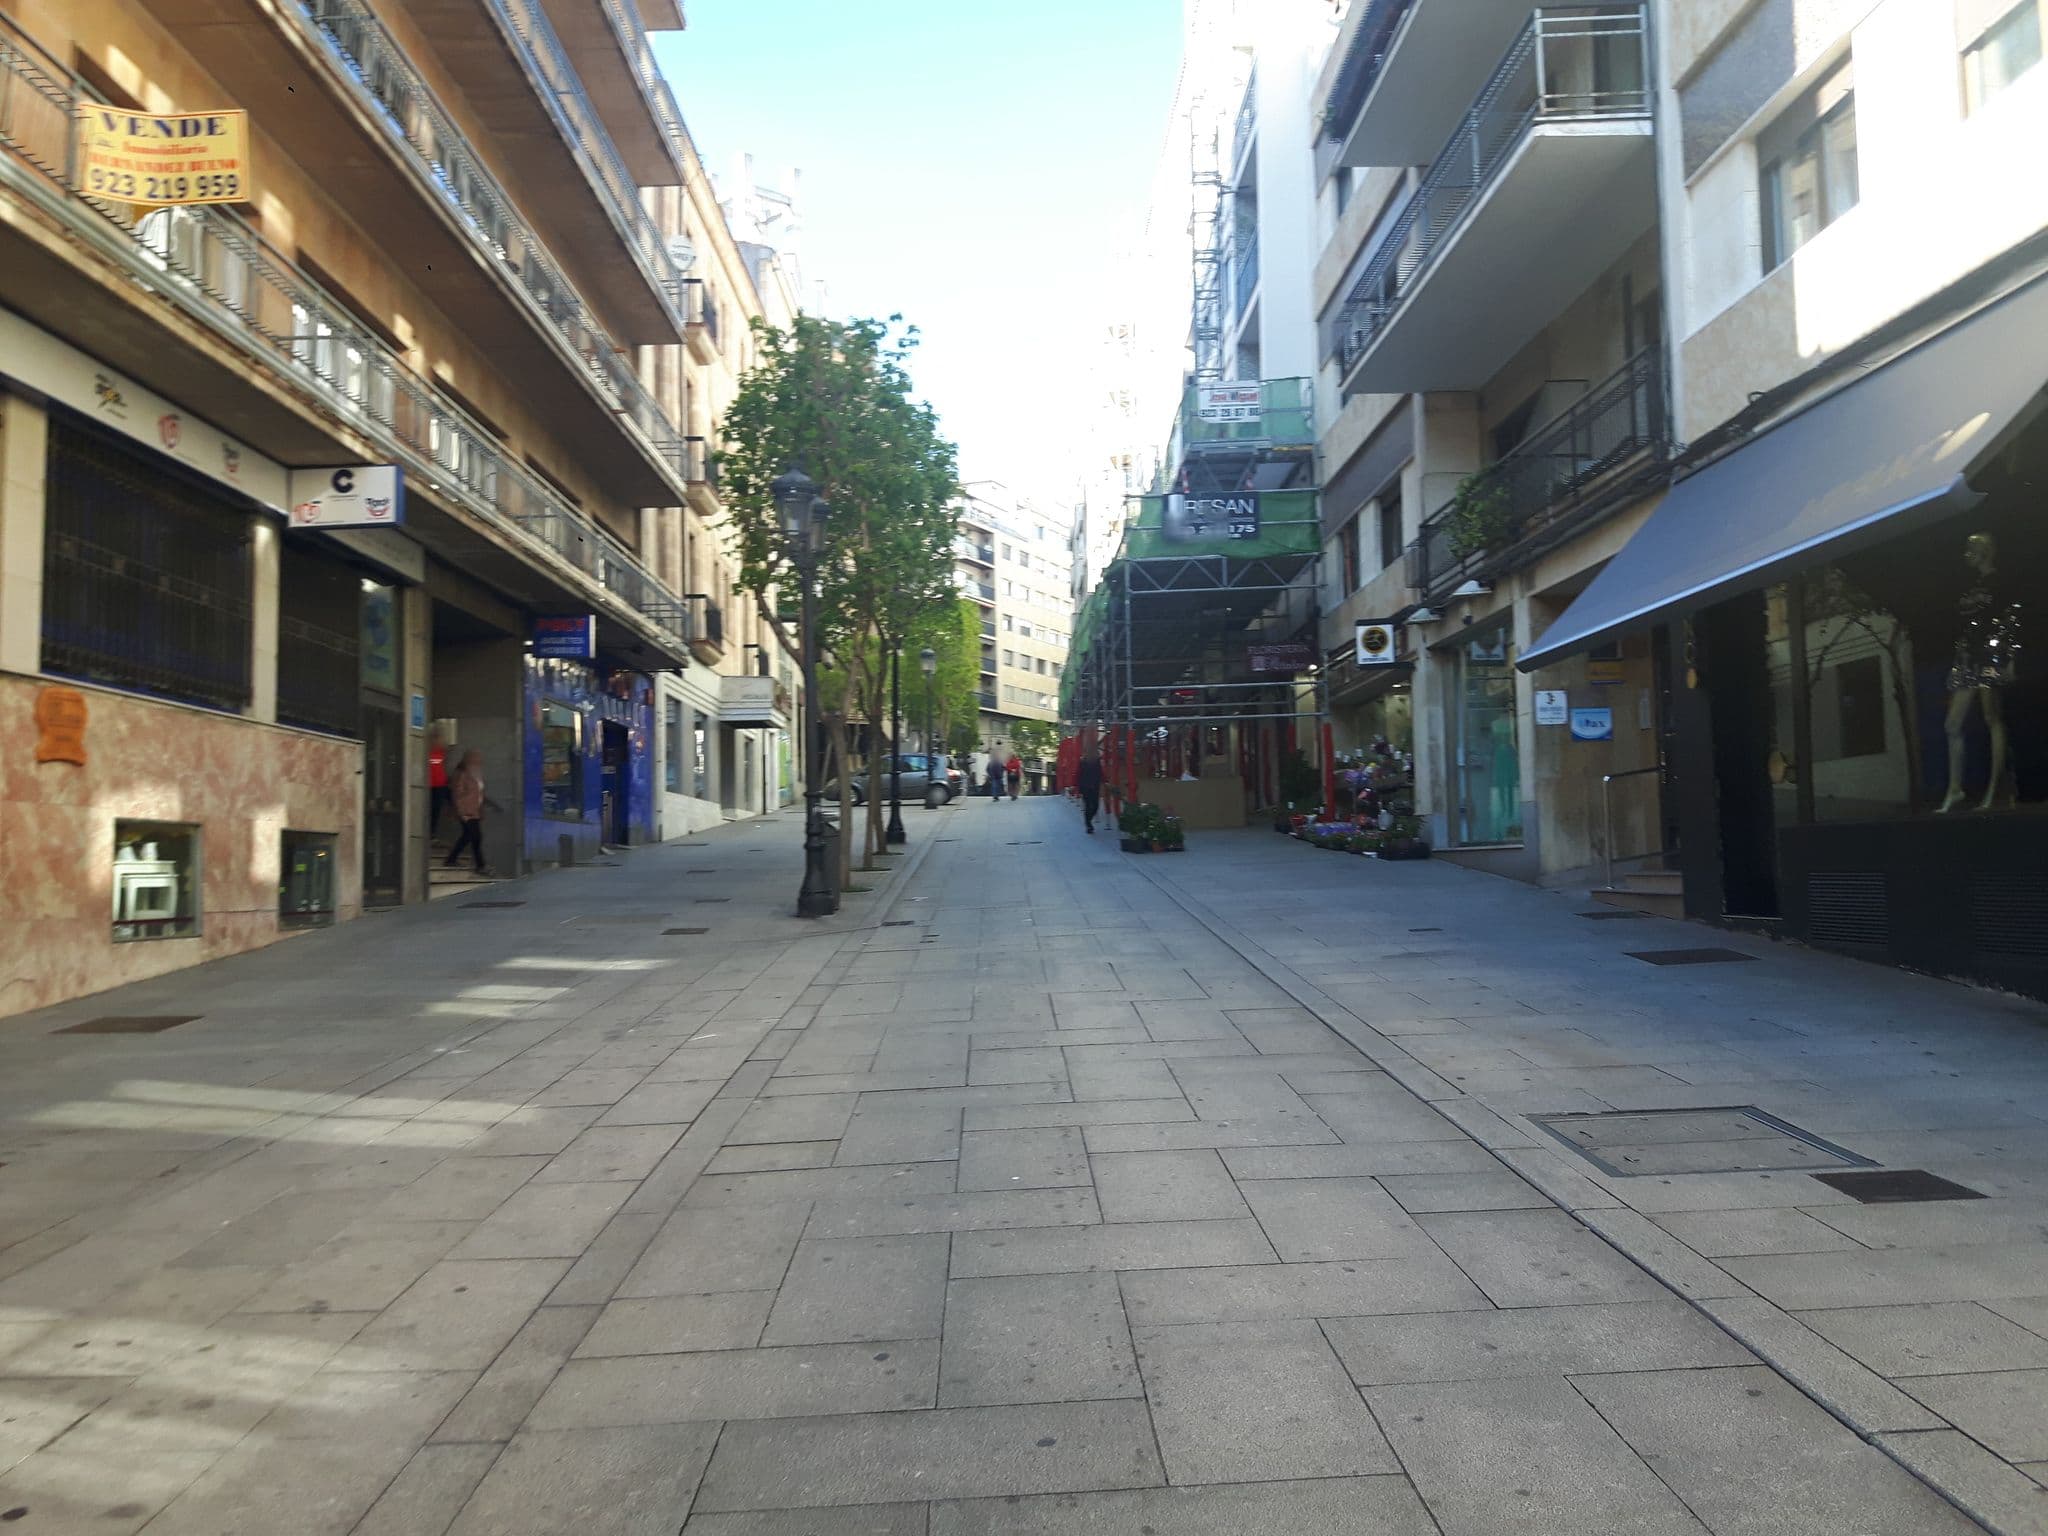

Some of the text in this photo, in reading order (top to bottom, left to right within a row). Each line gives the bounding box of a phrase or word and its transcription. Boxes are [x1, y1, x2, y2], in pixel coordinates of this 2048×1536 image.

[99, 112, 227, 138] VENDE
[91, 168, 239, 199] 923 219 959
